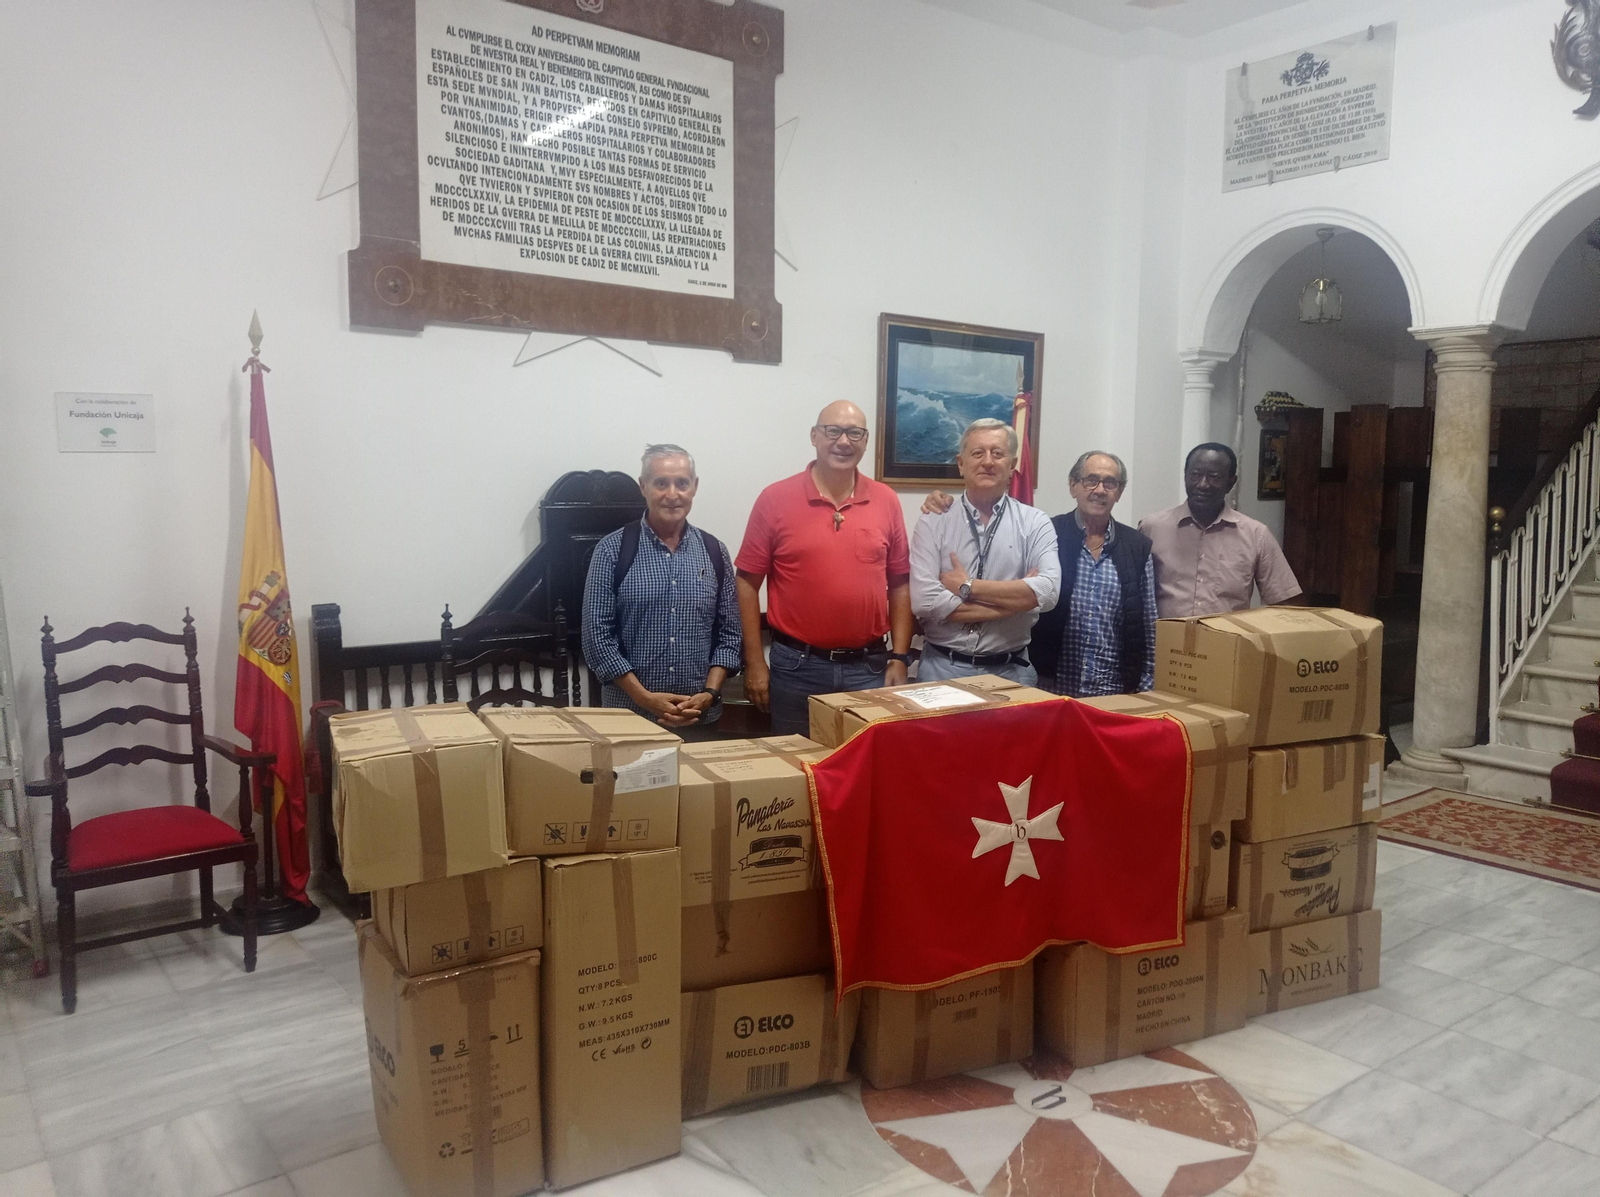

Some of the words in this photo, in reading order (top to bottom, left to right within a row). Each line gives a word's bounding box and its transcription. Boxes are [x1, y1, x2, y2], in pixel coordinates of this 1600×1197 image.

[531, 25, 543, 38] AD
[545, 28, 593, 50] PERPETVAM
[595, 41, 640, 62] MEMORIAM
[446, 25, 456, 37] AL
[458, 28, 502, 48] CVMPLIRSE
[504, 39, 513, 51] EL
[515, 42, 535, 56] CXXV
[537, 47, 585, 68] ANIVERSARIO
[587, 59, 600, 72] DEL
[601, 62, 634, 80] CAPITVLO
[635, 71, 665, 87] GENERAL
[666, 78, 709, 98] FVNDACIONAL
[431, 48, 511, 76] ESTABLECIMIENTO
[515, 67, 525, 79] EN
[529, 71, 557, 86] CADIZ,
[561, 78, 575, 90] LOS
[579, 82, 628, 102] CABALLEROS
[639, 96, 664, 111] DAMAS
[667, 102, 721, 123] HOSPITALARIOS
[470, 44, 480, 56] DE
[483, 46, 517, 64] NVESTRA
[519, 55, 538, 69] REAL
[547, 62, 592, 82] BENEMERITA
[593, 73, 637, 92] INSTITVCION,
[639, 84, 649, 95] ASI
[651, 87, 671, 100] COMO
[672, 92, 681, 103] DE
[682, 94, 691, 105] SV
[1261, 94, 1278, 104] PARA
[1279, 85, 1312, 100] PERPETVA
[1314, 76, 1346, 91] MEMORIA
[445, 131, 497, 151] SILENCIOSO
[509, 144, 580, 167] ININTERRVMPIDO
[591, 160, 605, 172] LOS
[608, 163, 625, 175] MAS
[628, 167, 690, 188] DESFAVORECIDOS
[693, 179, 702, 190] DE
[704, 181, 713, 192] LA
[427, 155, 478, 174] OCVLTANDO
[481, 164, 572, 190] INTENCIONADAMENTE
[575, 181, 590, 193] SVS
[593, 184, 630, 200] NOMBRES
[640, 193, 666, 206] ACTOS,
[669, 198, 695, 212] DIERON
[698, 203, 716, 215] TODO
[718, 207, 726, 217] LO
[435, 183, 501, 204] MDCCCLXXXIV,
[504, 194, 514, 206] LA
[518, 197, 558, 213] EPIDEMIA
[561, 204, 571, 215] DE
[574, 206, 598, 219] PESTE
[601, 211, 611, 222] DE
[614, 213, 666, 230] MDCCCLXXXV,
[669, 222, 677, 232] LA
[680, 224, 710, 238] LLEGADA
[713, 229, 721, 239] DE
[459, 174, 476, 186] QVE
[479, 177, 521, 194] TVVIERON
[533, 187, 573, 203] SVPIERON
[576, 194, 592, 206] CON
[596, 198, 629, 212] OCASION
[632, 204, 641, 214] DE
[644, 206, 658, 217] LOS
[660, 209, 692, 223] SEISMOS
[694, 215, 703, 225] DE
[454, 225, 491, 240] MVCHAS
[495, 231, 533, 246] FAMILIAS
[537, 237, 573, 252] DESPVES
[576, 243, 586, 254] DE
[589, 245, 598, 255] LA
[601, 247, 631, 260] GVERRA
[634, 252, 652, 263] CIVIL
[656, 255, 691, 268] ESPAÑOLA
[700, 261, 708, 271] LA
[520, 248, 565, 263] EXPLOSION
[568, 254, 578, 265] DE
[581, 256, 605, 268] CADIZ
[608, 260, 618, 270] DE
[620, 262, 659, 276] MCMXLVII.
[69, 410, 112, 419] Fundación
[114, 411, 144, 421] Unicaja
[1313, 660, 1339, 674] ELCO
[736, 797, 795, 837] Panadería
[757, 821, 772, 833] Las
[578, 963, 617, 977] MODELO:
[1154, 955, 1180, 971] ELCO
[604, 979, 621, 988] PCS
[602, 998, 614, 1007] 7.2
[615, 994, 633, 1004] KGS
[936, 994, 967, 1007] DELO:
[602, 1015, 615, 1025] 9.5
[616, 1011, 634, 1021] KGS
[758, 1014, 794, 1033] ELCO
[1136, 1009, 1163, 1020] MADRID
[1135, 1022, 1160, 1034] HECHO
